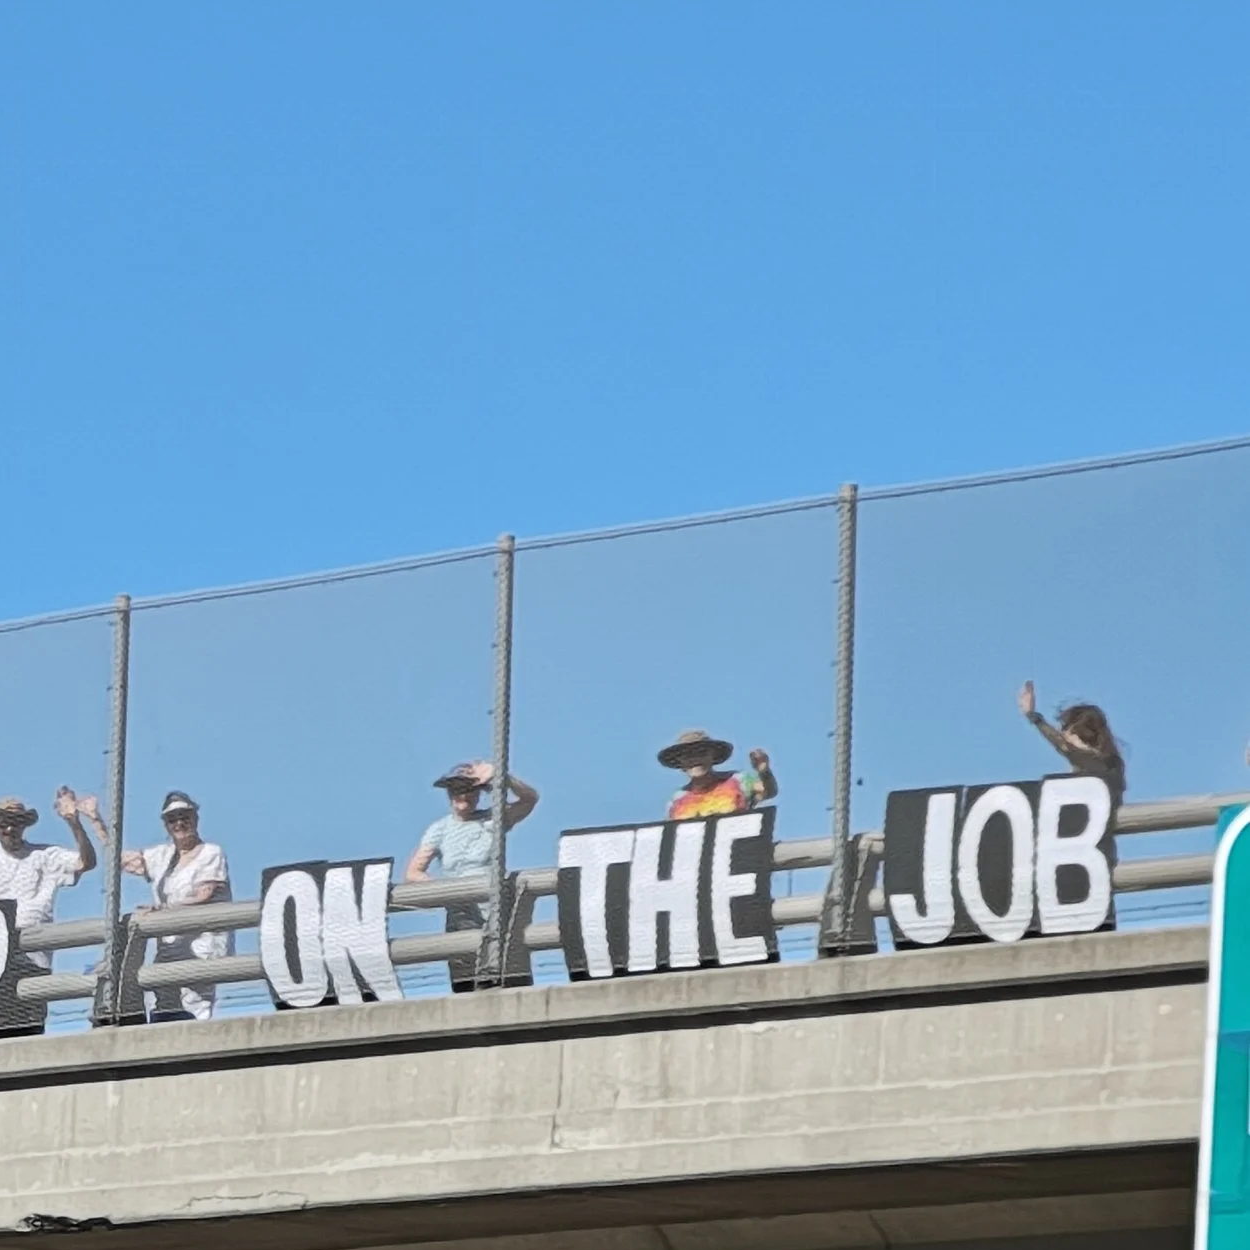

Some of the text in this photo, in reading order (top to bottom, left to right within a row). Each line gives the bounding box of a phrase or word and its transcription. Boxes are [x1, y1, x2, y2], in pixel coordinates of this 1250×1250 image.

[260, 864, 402, 1008] ON
[558, 813, 768, 978] THE
[889, 776, 1111, 943] JOB
